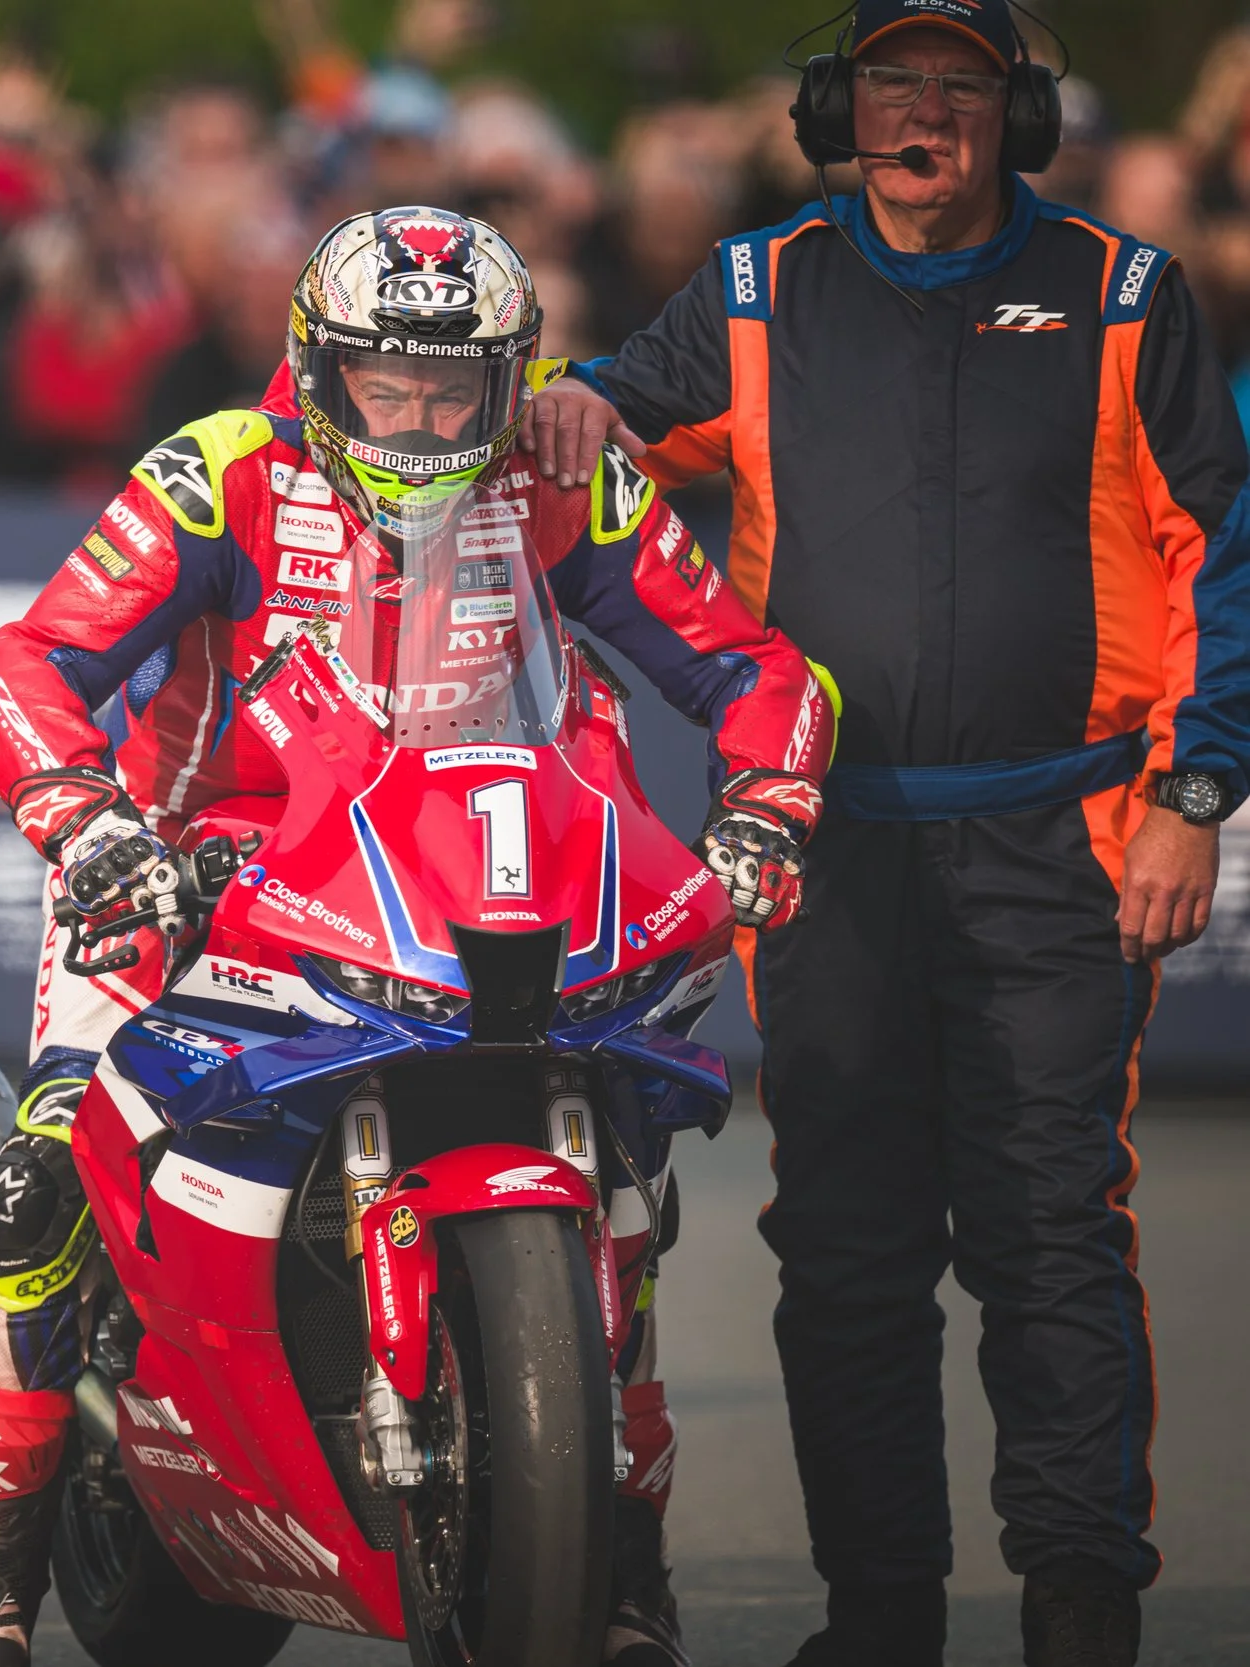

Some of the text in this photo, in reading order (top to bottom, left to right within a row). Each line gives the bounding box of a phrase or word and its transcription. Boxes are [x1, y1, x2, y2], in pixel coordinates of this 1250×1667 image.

[947, 3, 971, 16] MAN
[731, 243, 756, 304] sparco
[1119, 248, 1157, 306] sparco
[325, 279, 349, 321] HONDA
[331, 273, 354, 312] smiths
[386, 280, 468, 304] KYT
[493, 286, 516, 323] smiths
[499, 288, 523, 329] HONDA
[993, 304, 1066, 332] TT
[328, 331, 373, 348] TITANTECH
[406, 339, 484, 358] Bennetts
[351, 443, 488, 472] REDTORPEDO.COM
[297, 482, 328, 492] Brothers
[488, 470, 534, 495] OTUL
[378, 498, 400, 512] Joe
[280, 516, 336, 533] HONDA
[309, 534, 326, 542] PARTS
[463, 536, 515, 549] Snap-on
[287, 576, 338, 588] TAKASAGO CHAIN
[288, 555, 340, 582] RK
[482, 565, 506, 575] RACING
[483, 574, 507, 585] CLUTCH
[290, 596, 351, 615] NISSIN
[470, 601, 512, 611] BlueEarth
[470, 608, 513, 617] Construction
[447, 623, 516, 651] KYT
[440, 650, 509, 669] METZELER
[292, 647, 340, 714] Honda RACING
[248, 698, 293, 749] MOTUL
[799, 696, 823, 770] IREBLADE
[429, 751, 517, 765] METZELER
[469, 778, 530, 897] 1
[256, 890, 305, 923] Vehicle Hire
[643, 867, 712, 931] Close Brothers
[264, 878, 377, 949] Close Brothers
[479, 911, 542, 922] HONDA
[654, 909, 690, 942] Vehicle Hire
[211, 962, 273, 996] HRC
[213, 983, 276, 1003] Honda RACING
[155, 1036, 225, 1067] FIREBLAD
[181, 1172, 225, 1199] HONDA
[490, 1183, 570, 1197] HONDA
[375, 1228, 395, 1321] METZELER
[601, 1246, 614, 1339] METZELER
[131, 1444, 205, 1475] METZELER
[232, 1577, 369, 1633] HONDA
